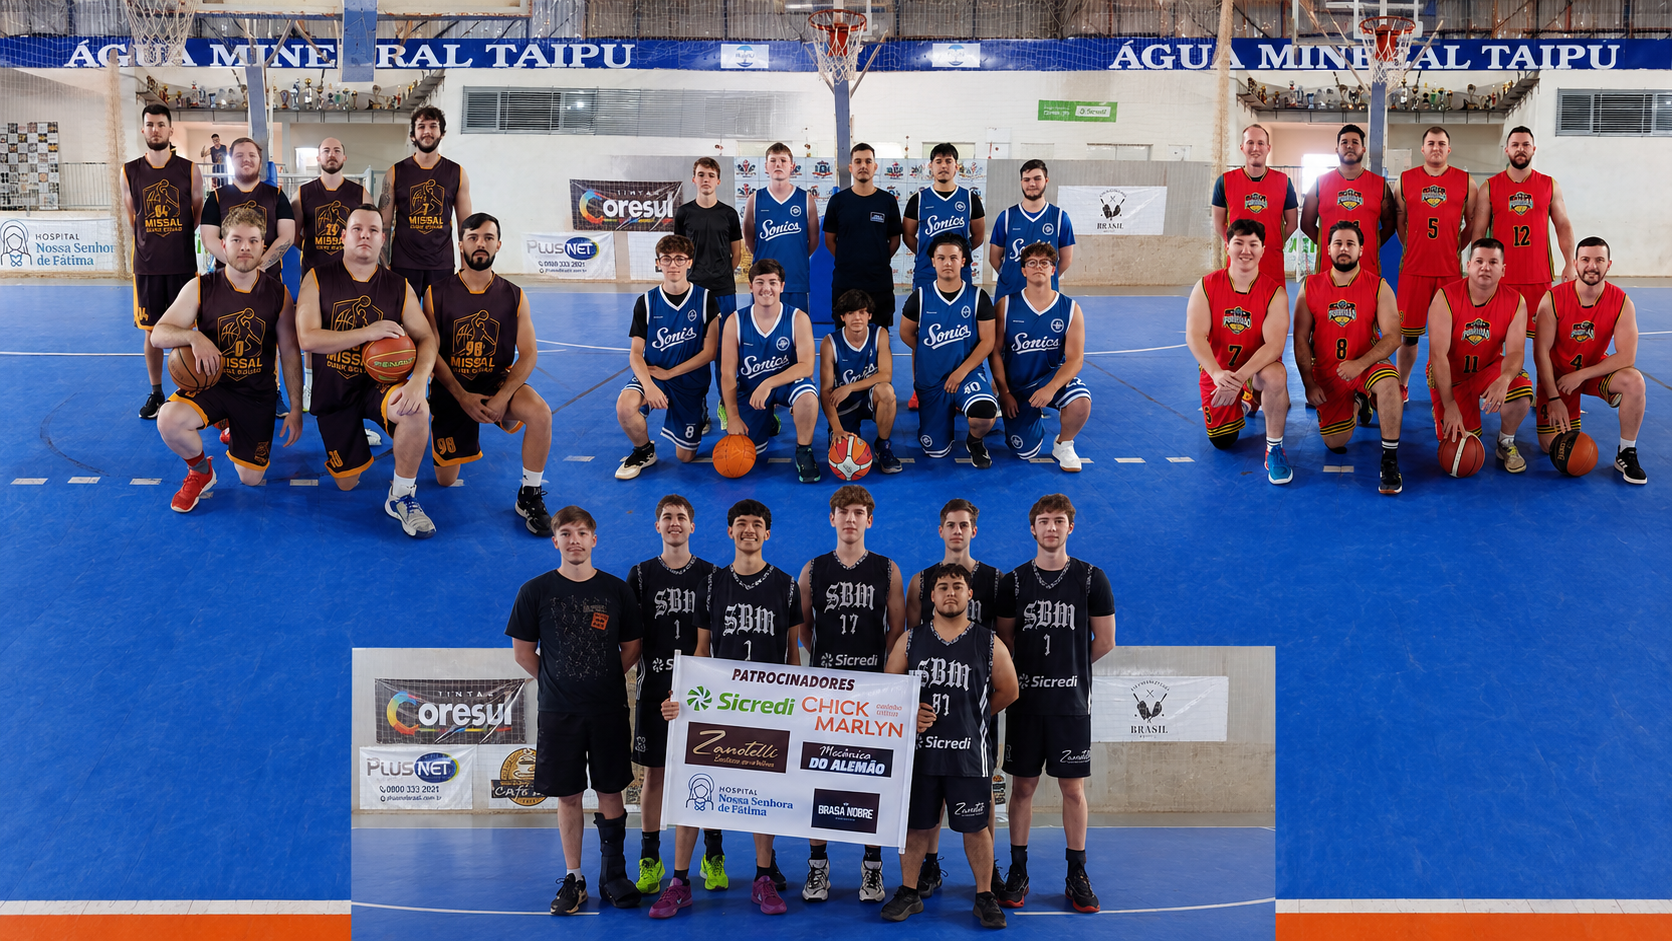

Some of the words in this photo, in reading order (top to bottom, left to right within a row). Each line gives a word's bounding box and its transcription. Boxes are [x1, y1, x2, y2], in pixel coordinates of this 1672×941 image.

[64, 38, 198, 68] ÁGUA
[486, 43, 636, 69] TAIPU
[1257, 43, 1472, 70] MINEAL
[1481, 44, 1621, 70] TAIPU
[579, 188, 675, 225] Coresul
[145, 218, 183, 228] MISSAL
[408, 215, 444, 226] MISSAL
[759, 218, 802, 242] Sonics
[924, 214, 966, 238] Sonics
[1427, 217, 1440, 240] 5
[35, 232, 80, 241] HOSPITAL
[1513, 225, 1531, 248] 12
[36, 242, 72, 254] Nossa
[37, 255, 51, 267] de
[52, 253, 95, 267] Fátima
[234, 340, 245, 358] 0
[1011, 332, 1060, 355] Sonics
[1335, 338, 1348, 360] 8
[222, 357, 263, 369] ISSAL
[326, 351, 364, 366] MISS
[450, 356, 496, 368] MISSAL
[1228, 345, 1243, 367] 7
[1463, 354, 1479, 374] 11
[1569, 353, 1583, 371] 4
[684, 425, 695, 439] 8
[436, 436, 457, 455] 98
[822, 581, 876, 614] SBM
[722, 602, 776, 637] SBM
[839, 613, 859, 635] 17
[1022, 599, 1076, 632] SBM
[835, 654, 878, 666] Sicredi
[731, 667, 856, 692] PATROCINADORES
[1031, 674, 1078, 689] Sicredi
[386, 690, 513, 736] Coresul
[717, 691, 796, 716] Sicredi
[801, 695, 870, 718] CHICK
[814, 715, 904, 739] MARLYN
[1130, 725, 1169, 734] BRASIL
[925, 735, 972, 750] Sicredi
[808, 757, 829, 770] DO
[829, 759, 886, 775] ALEMÃO
[718, 786, 758, 796] HOSPITAL
[717, 803, 730, 813] de
[731, 804, 768, 817] Fátima
[718, 794, 750, 805] Nossa
[750, 796, 794, 810] Senhora
[818, 804, 845, 816] BRASA
[846, 807, 874, 820] NOBRE
